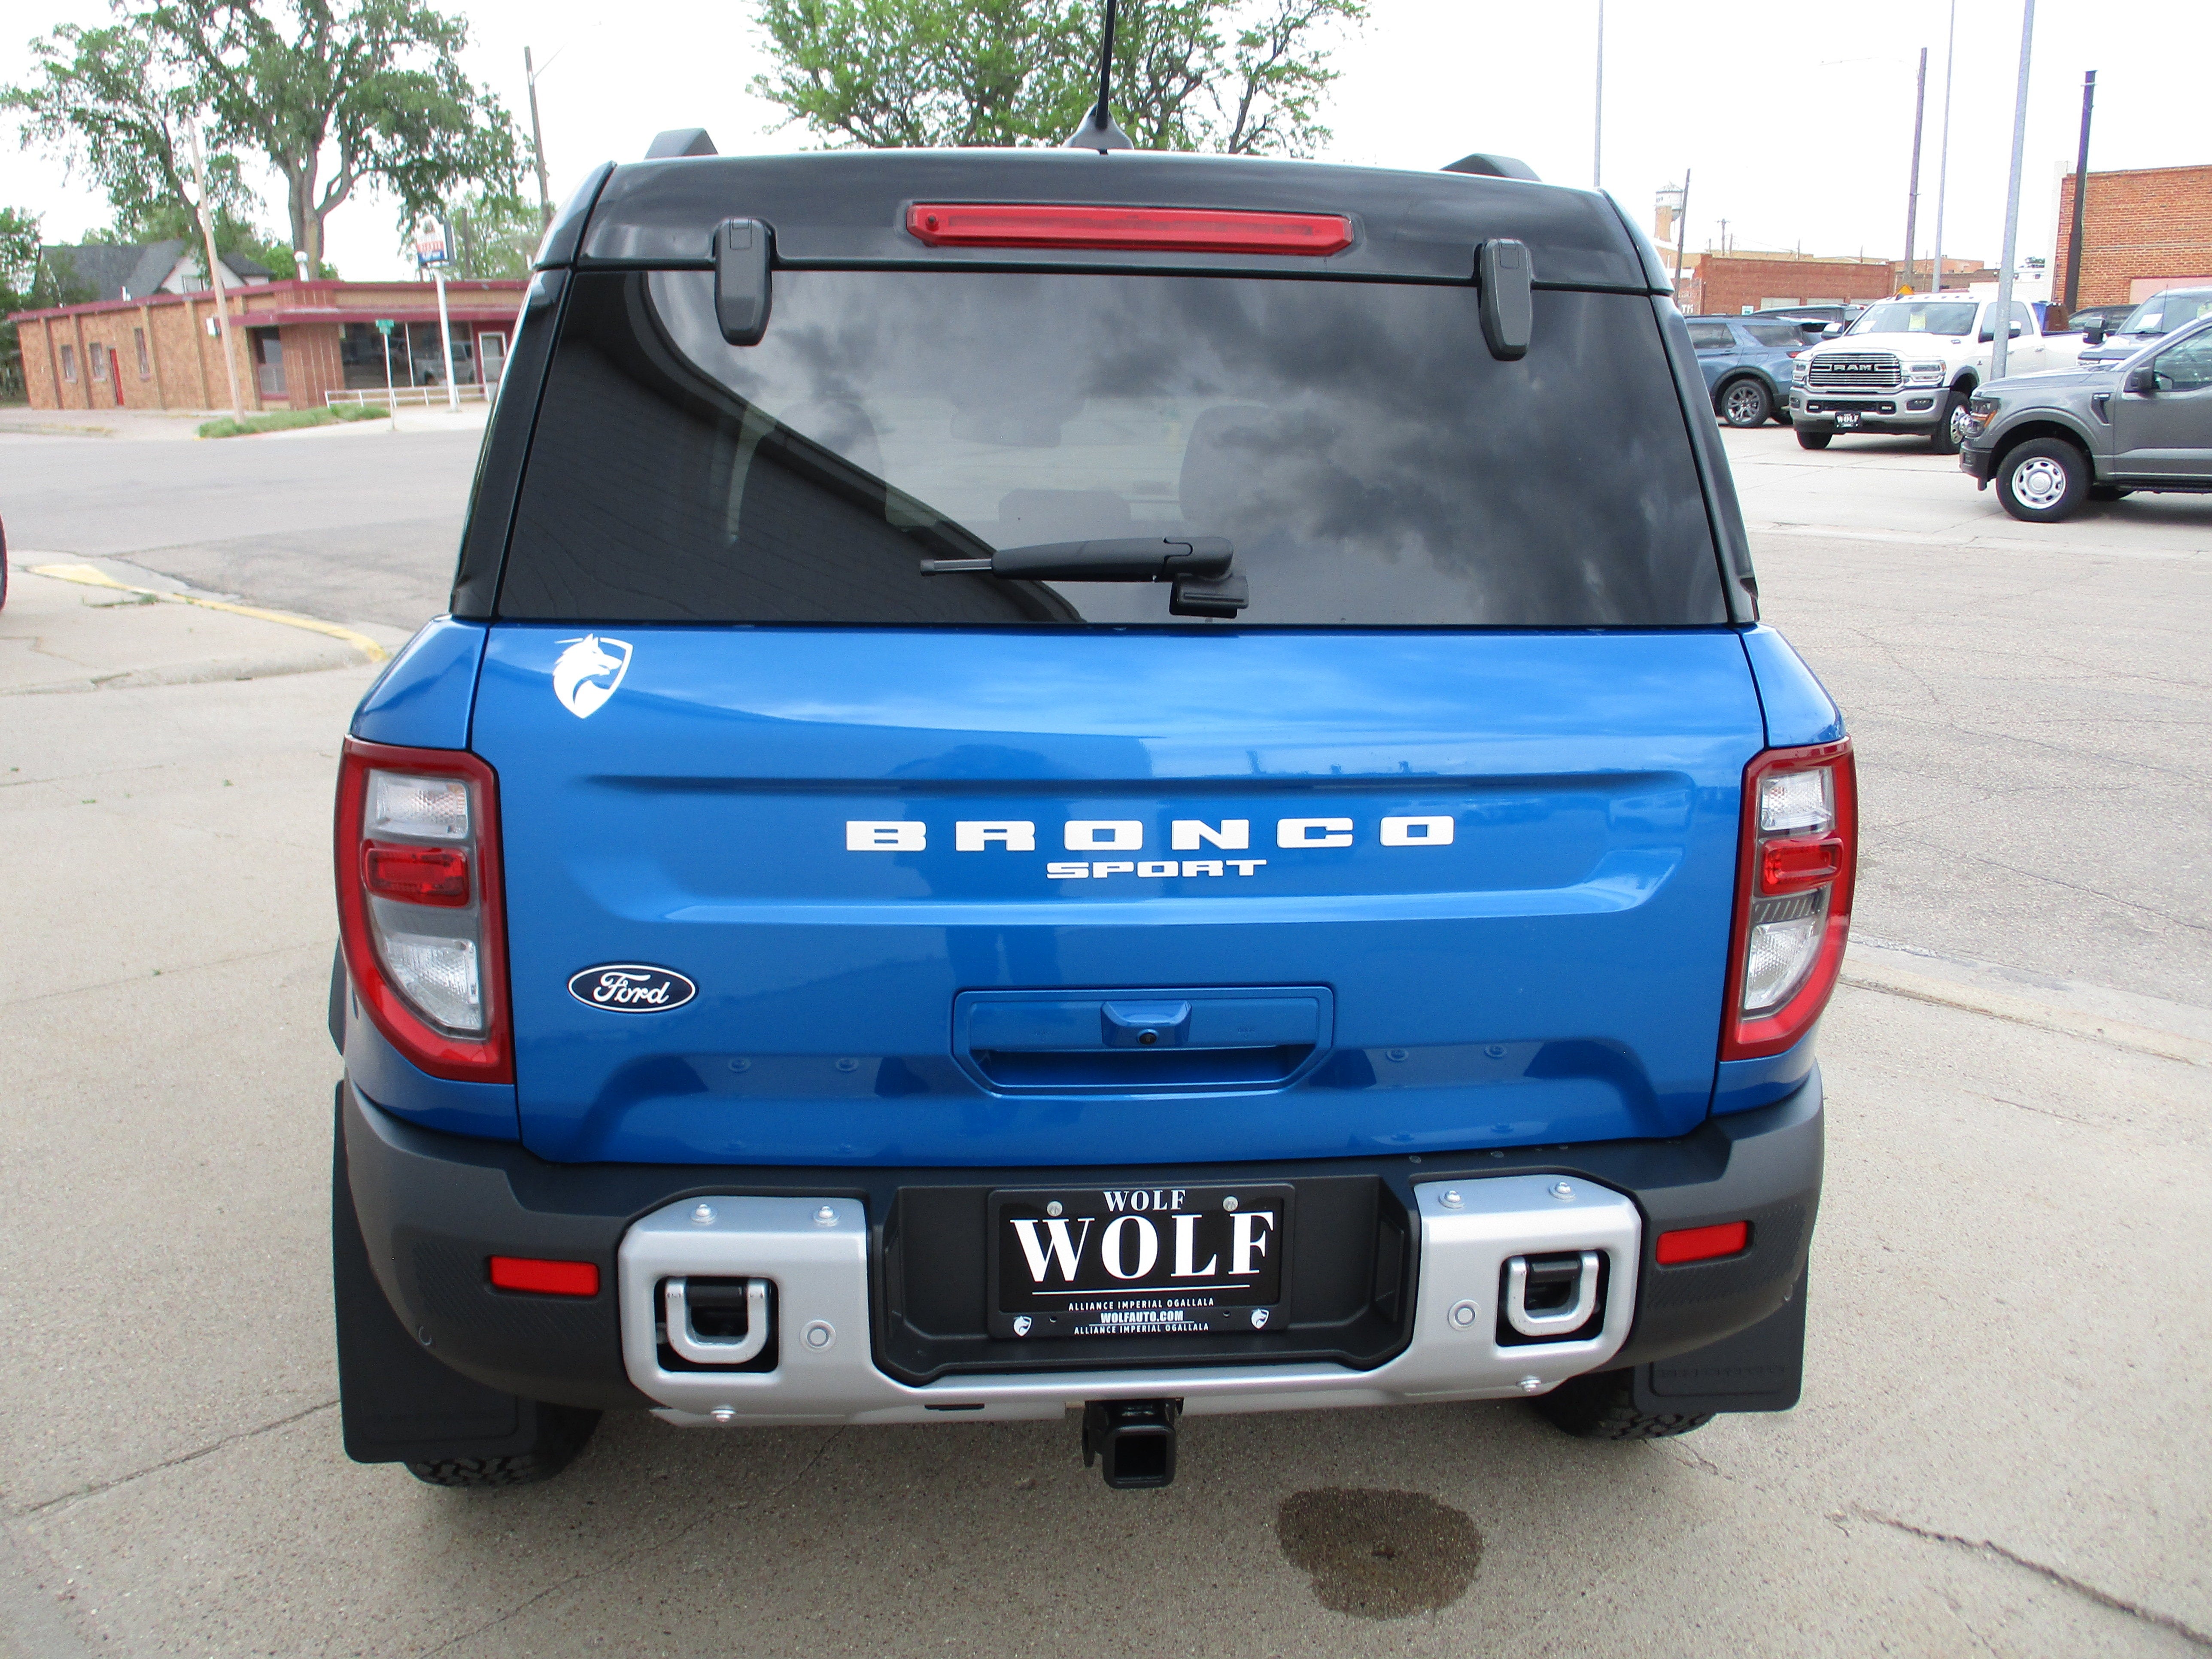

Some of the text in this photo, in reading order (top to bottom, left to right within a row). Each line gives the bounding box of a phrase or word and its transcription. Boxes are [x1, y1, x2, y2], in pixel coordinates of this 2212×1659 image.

[1837, 415, 1860, 423] WOLF
[846, 816, 1454, 851] BRONCO
[1047, 860, 1267, 879] SPORT
[592, 972, 671, 1004] Ford
[1103, 1189, 1186, 1212] WOLF
[1009, 1211, 1274, 1283] WOLF
[1068, 1297, 1214, 1311] ALLIANCE IMPERIAL OGALLALA
[1100, 1310, 1184, 1324] WOLFAUTO.COM
[1074, 1322, 1209, 1335] ALLIANCE IMPERIAL OGALLALA
